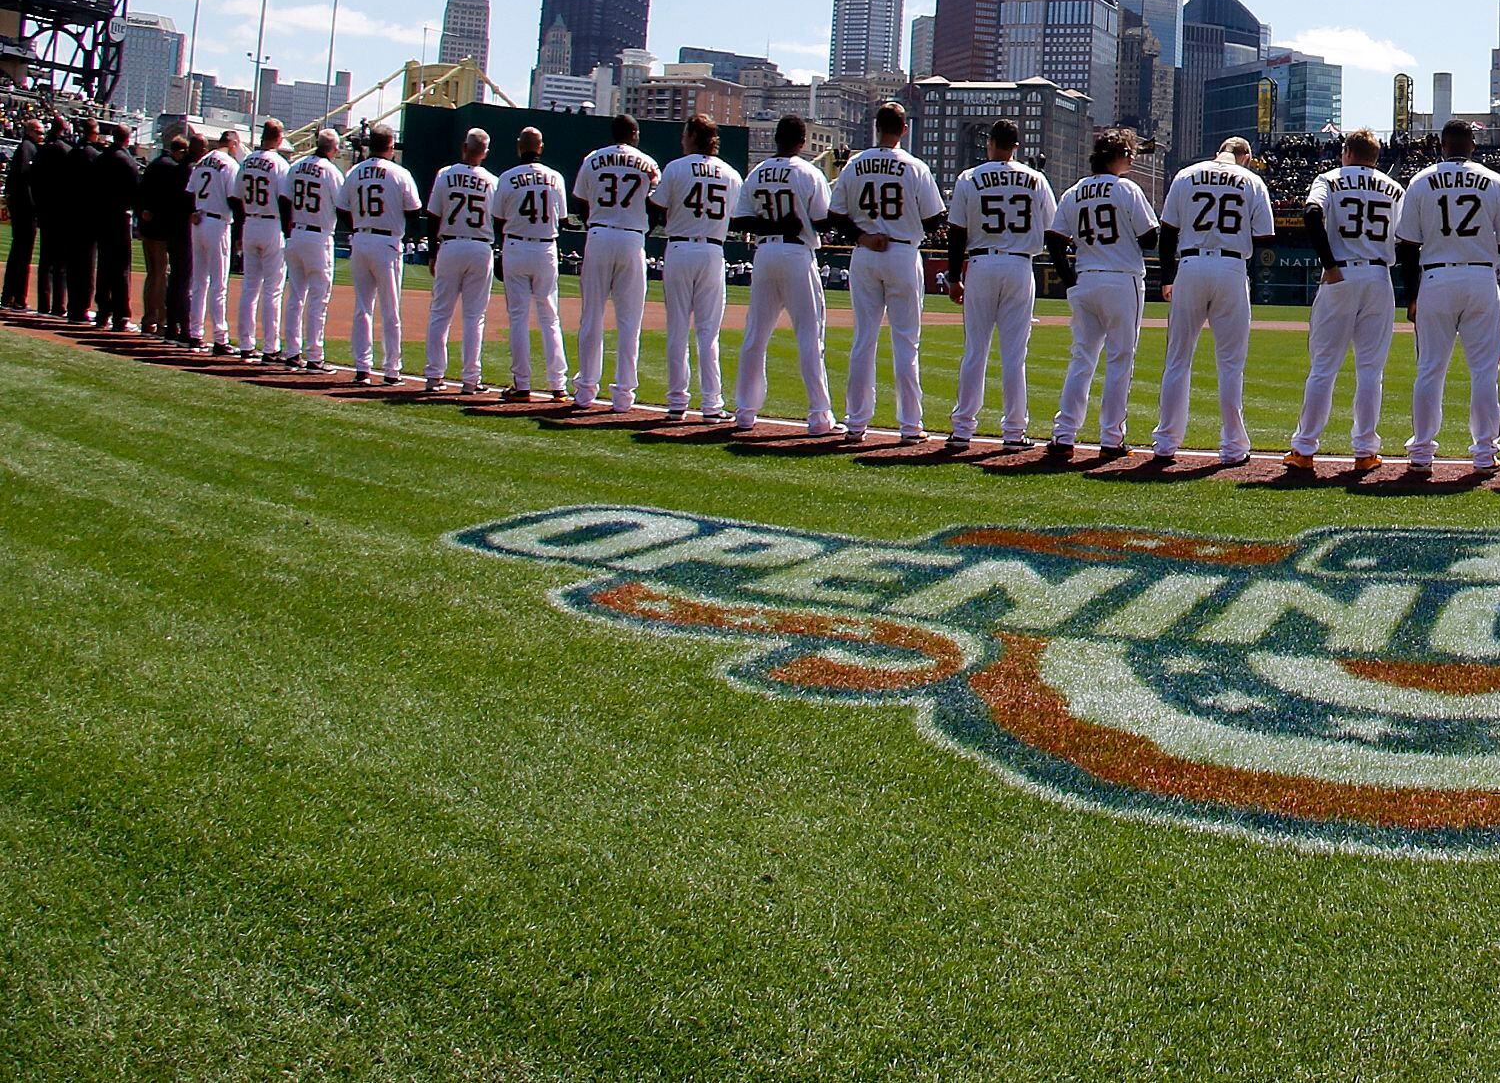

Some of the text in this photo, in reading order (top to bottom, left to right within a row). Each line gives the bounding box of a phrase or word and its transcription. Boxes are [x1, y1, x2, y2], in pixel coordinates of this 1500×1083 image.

[110, 21, 125, 32] Lite
[447, 172, 490, 194] LIVESEY
[509, 172, 556, 190] SOFIELD
[691, 162, 722, 179] COLE
[758, 167, 792, 184] FELIZ
[855, 158, 905, 177] HUGHES
[972, 170, 1037, 191] LOBSTEIN
[1191, 171, 1246, 191] LUEBKE
[1427, 171, 1492, 192] NICASIO
[198, 171, 212, 199] 2
[243, 174, 270, 207] 36
[293, 179, 321, 213] 85
[357, 184, 385, 217] 16
[598, 173, 642, 209] 37
[683, 182, 728, 220] 45
[858, 181, 904, 220] 48
[1075, 182, 1114, 203] LOCKE
[1327, 174, 1403, 203] MELANCON
[448, 192, 486, 228] 75
[518, 190, 550, 224] 41
[981, 194, 1033, 234] 53
[1192, 192, 1245, 235] 26
[1338, 197, 1392, 242] 35
[1438, 194, 1482, 237] 12
[1078, 203, 1120, 246] 49
